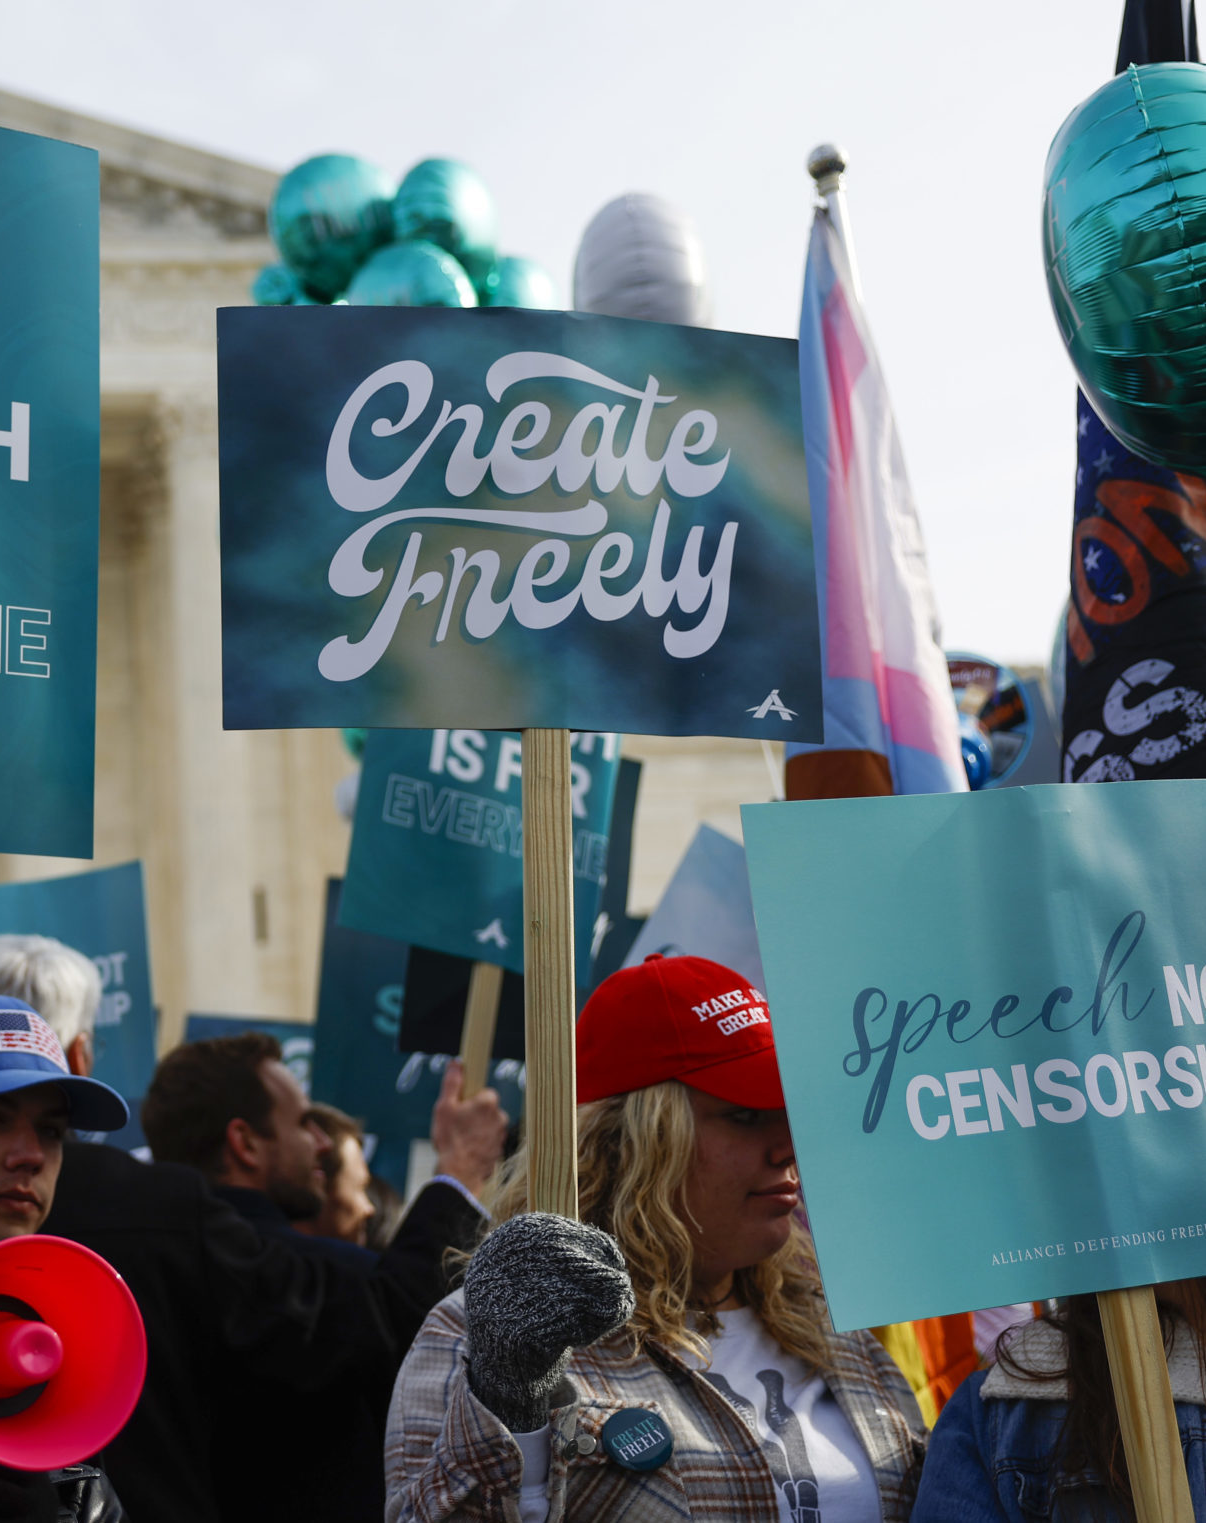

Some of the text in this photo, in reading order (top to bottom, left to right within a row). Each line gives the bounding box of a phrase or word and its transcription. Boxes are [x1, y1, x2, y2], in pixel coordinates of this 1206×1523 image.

[326, 351, 731, 513] Create
[318, 498, 739, 682] Freely
[428, 729, 487, 783] IS
[494, 736, 591, 819] FR
[382, 772, 609, 882] EVERYE
[691, 989, 750, 1022] MAKE
[843, 910, 1206, 1133] speech N
[991, 1222, 1206, 1266] ALLIANCE DEFENDING FREE
[611, 1416, 656, 1450] CREATE
[619, 1425, 665, 1461] FREELY
